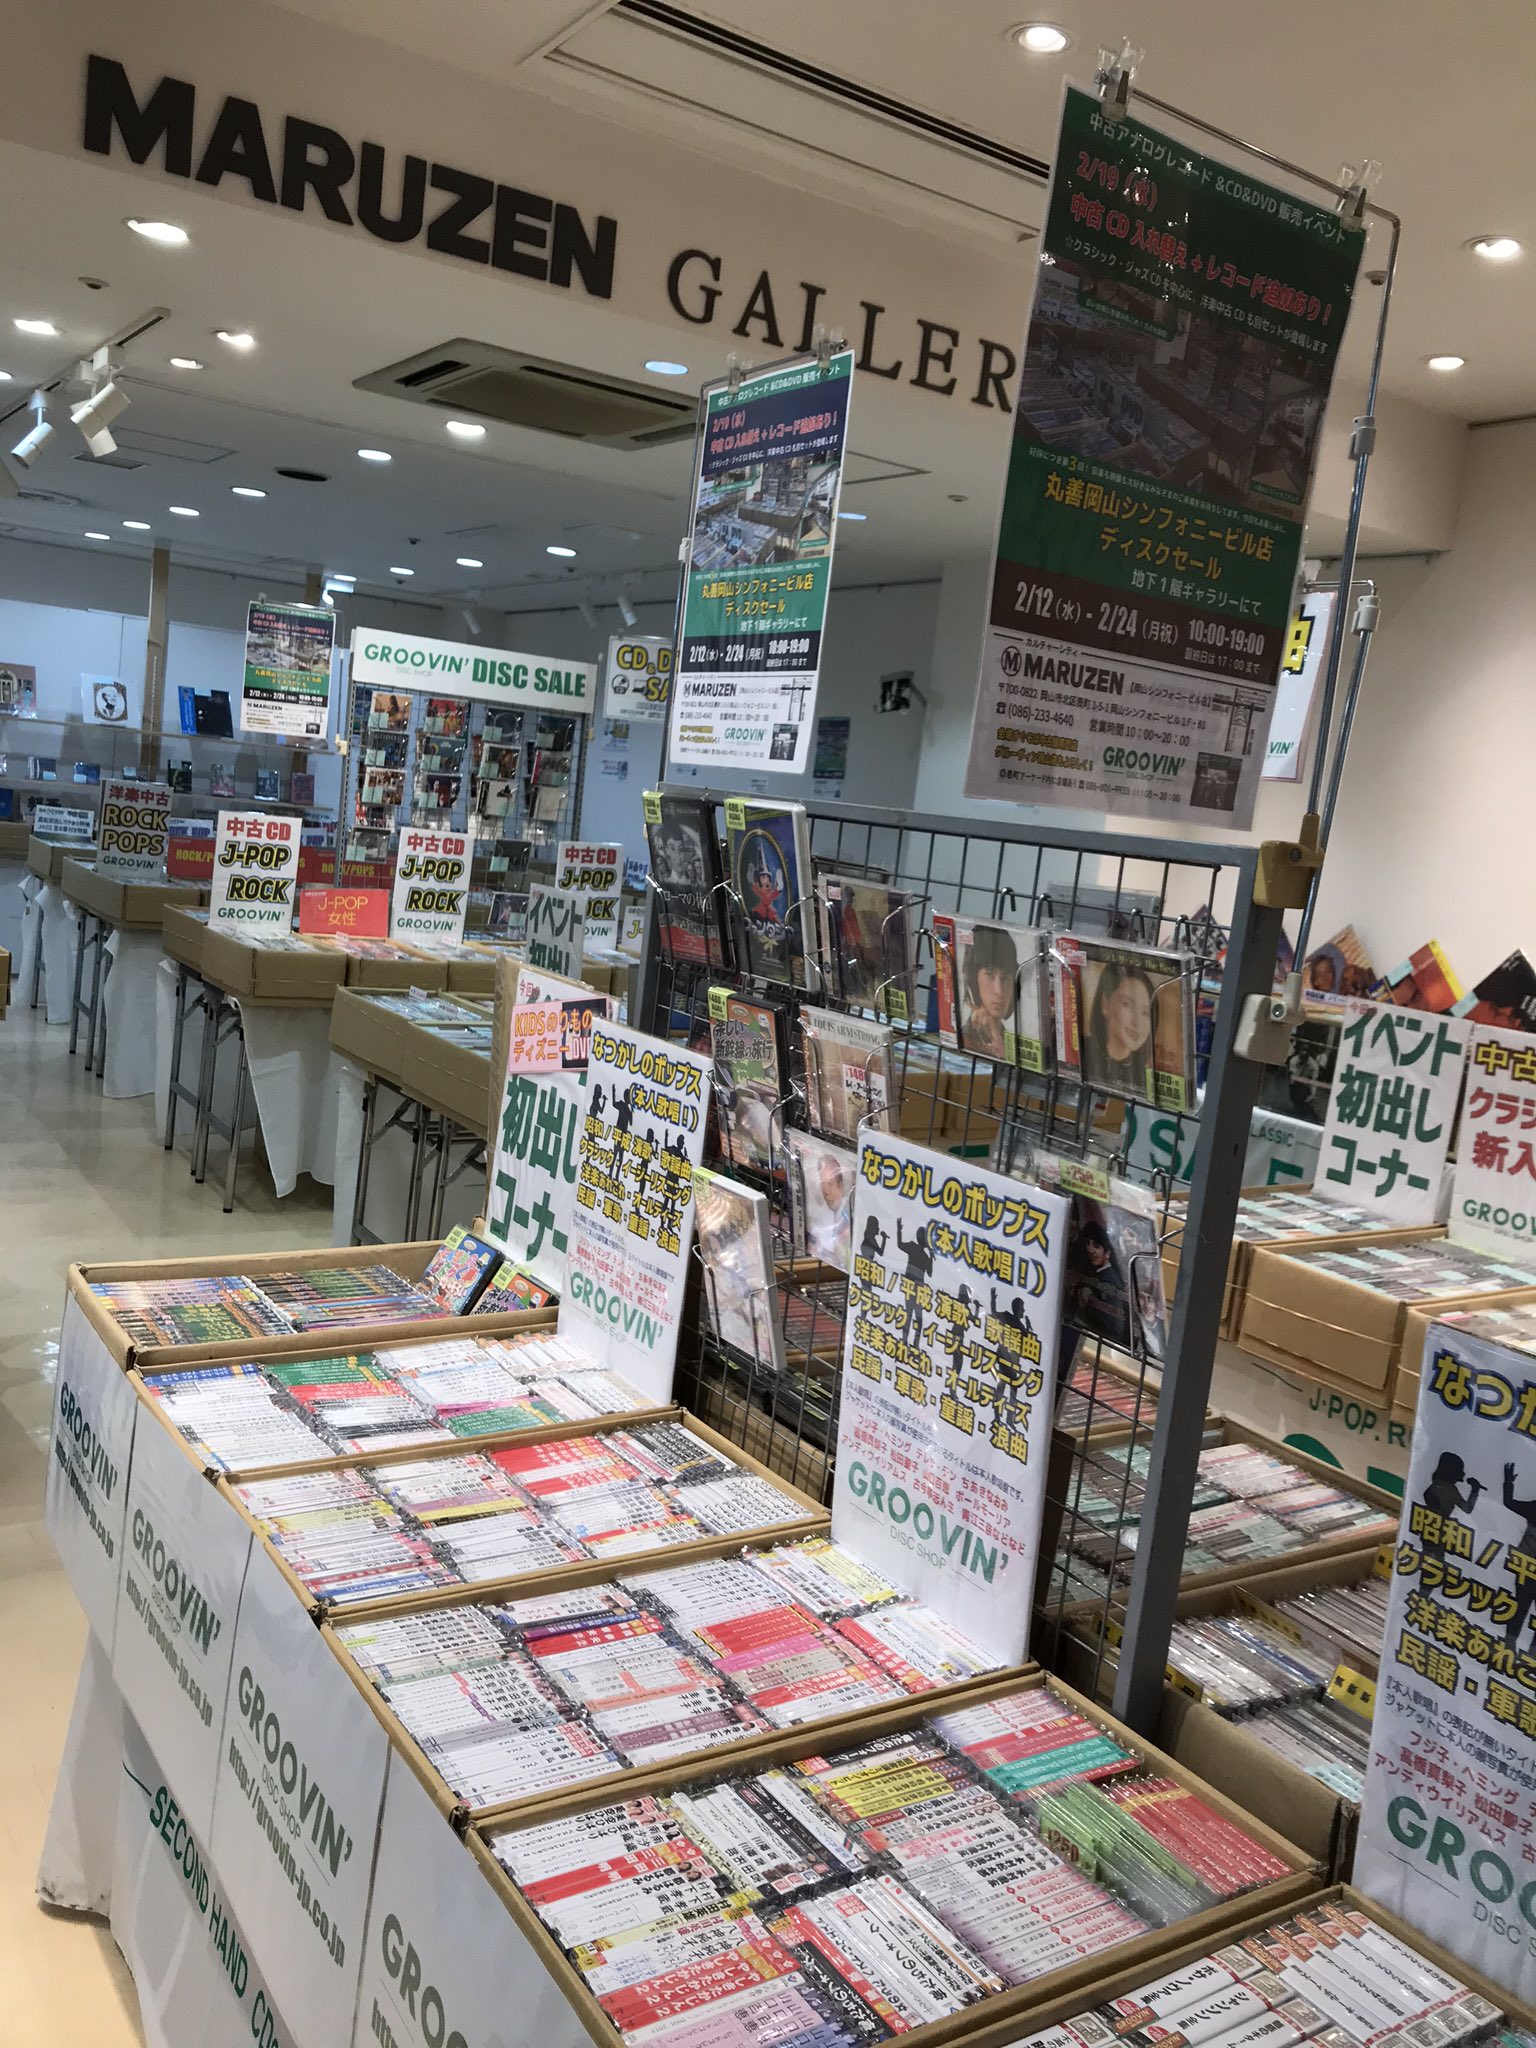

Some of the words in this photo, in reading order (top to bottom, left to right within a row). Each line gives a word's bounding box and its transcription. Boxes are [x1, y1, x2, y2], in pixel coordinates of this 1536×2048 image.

[1090, 112, 1213, 184] 中古アナログレコード
[1279, 201, 1347, 244] 販売イベント
[84, 54, 618, 299] MARUZEN
[668, 249, 1016, 413] GALLER
[1071, 193, 1103, 229] 中古
[1106, 208, 1130, 238] CD
[1131, 221, 1188, 270] 入れ替え
[1043, 470, 1275, 563] 丸善岡山シンフォニービル店
[1099, 526, 1223, 581] ディスクセール
[701, 571, 815, 600] 丸善岡山シンフォニービル店
[725, 598, 786, 617] ディスクセール
[1097, 601, 1139, 639] 2/24
[1188, 618, 1266, 658] 10:00-19:00
[364, 643, 469, 674] GROOVIN'
[472, 657, 528, 690] DISC
[533, 666, 587, 699] SALE
[616, 643, 672, 676] CD&D
[725, 643, 745, 663] 2/24
[1023, 651, 1126, 697] MARUZEN
[253, 703, 283, 712] MARUZEN
[691, 682, 737, 698] MARUZEN
[724, 726, 767, 742] GROOVIN'
[1103, 745, 1186, 778] GROOVIN'
[101, 803, 171, 833] ROCK
[109, 784, 170, 807] 洋楽中古
[101, 828, 166, 857] POPS
[226, 817, 265, 839] 中古
[265, 818, 292, 841] CD
[407, 833, 440, 854] 中古
[441, 836, 465, 857] CD
[102, 855, 159, 871] GROOVIN'
[218, 840, 293, 871] J-POP
[321, 861, 376, 878] ROK/POPS
[399, 854, 466, 882] J-POP
[564, 846, 595, 866] 中古
[596, 848, 617, 866] CD
[226, 874, 295, 904] ROCK
[404, 888, 467, 916] ROCK
[557, 866, 618, 892] J-POP
[217, 906, 285, 923] GROOVIN'
[317, 894, 369, 912] J-POP
[327, 911, 358, 927] 女性
[396, 916, 457, 933] GROOVIN'
[528, 893, 584, 943] イベント
[583, 896, 620, 922] OCK
[514, 1009, 547, 1038] KIDS
[546, 1007, 593, 1034] のりもの
[812, 1016, 835, 1036] LOUIS
[833, 1020, 882, 1045] ARMSTRONG
[1343, 1011, 1463, 1077] イベント
[512, 1038, 571, 1065] ディズニー
[570, 1036, 592, 1062] DV
[592, 1029, 703, 1102] なつかしのポップス
[627, 1083, 700, 1134] （本人歌唱！）
[1335, 1063, 1443, 1144] 初出し
[1468, 1085, 1536, 1131] クラシ
[500, 1076, 578, 1184] 初出し
[1249, 1122, 1296, 1149] LASSIC
[578, 1137, 693, 1208] クラシック・イージーリスニング
[1325, 1133, 1432, 1198] コーナー
[1471, 1130, 1536, 1183] 新入
[489, 1169, 569, 1262] コーナー
[576, 1183, 681, 1258] 民謡・軍歌・童謡・浪曲
[579, 1161, 684, 1234] 洋楽あれこれ・オールディーズ
[859, 1144, 1051, 1258] なつかしのポップス
[925, 1217, 1048, 1299] （本人歌唱！）
[570, 1270, 665, 1351] GROOVIN'
[847, 1281, 1045, 1398] クラシック・イージーリスニング
[852, 1314, 1032, 1434] 洋楽あれこれ・オールディーズ
[850, 1343, 1030, 1467] 民謡・軍歌・童謡・浪曲
[59, 1380, 119, 1501] GROOVIN'
[889, 1447, 920, 1474] 松田聖子
[960, 1475, 1010, 1514] ちあきなおみ
[848, 1459, 1010, 1586] GROOVIN'
[1411, 1501, 1536, 1587] 昭和/平
[889, 1525, 916, 1551] DISC
[915, 1540, 947, 1572] SHOP
[132, 1508, 222, 1658] GROOVIN'
[1396, 1540, 1536, 1626] クラシック・
[1403, 1588, 1536, 1693] 洋楽あれこ
[1384, 1691, 1536, 1792] ジャケットに本人の顔写真が使
[237, 1665, 354, 1880] GROOVIN'
[1408, 1729, 1521, 1807] フジ子・ヘミング
[261, 1762, 280, 1807] DISC
[278, 1798, 302, 1842] SHOP
[1473, 1789, 1535, 1838] 松田聖子
[148, 1784, 210, 1916] SECOND
[207, 1892, 250, 2000] HAND
[631, 1867, 677, 1886] 都はるみ
[641, 1876, 686, 1896] 都はるみ
[681, 1899, 733, 1923] 村田英雄
[1472, 1899, 1522, 1946] DISC
[1140, 1965, 1219, 2005] ボサ・ノヴァ全集
[1176, 1991, 1250, 2031] シャンソン全集
